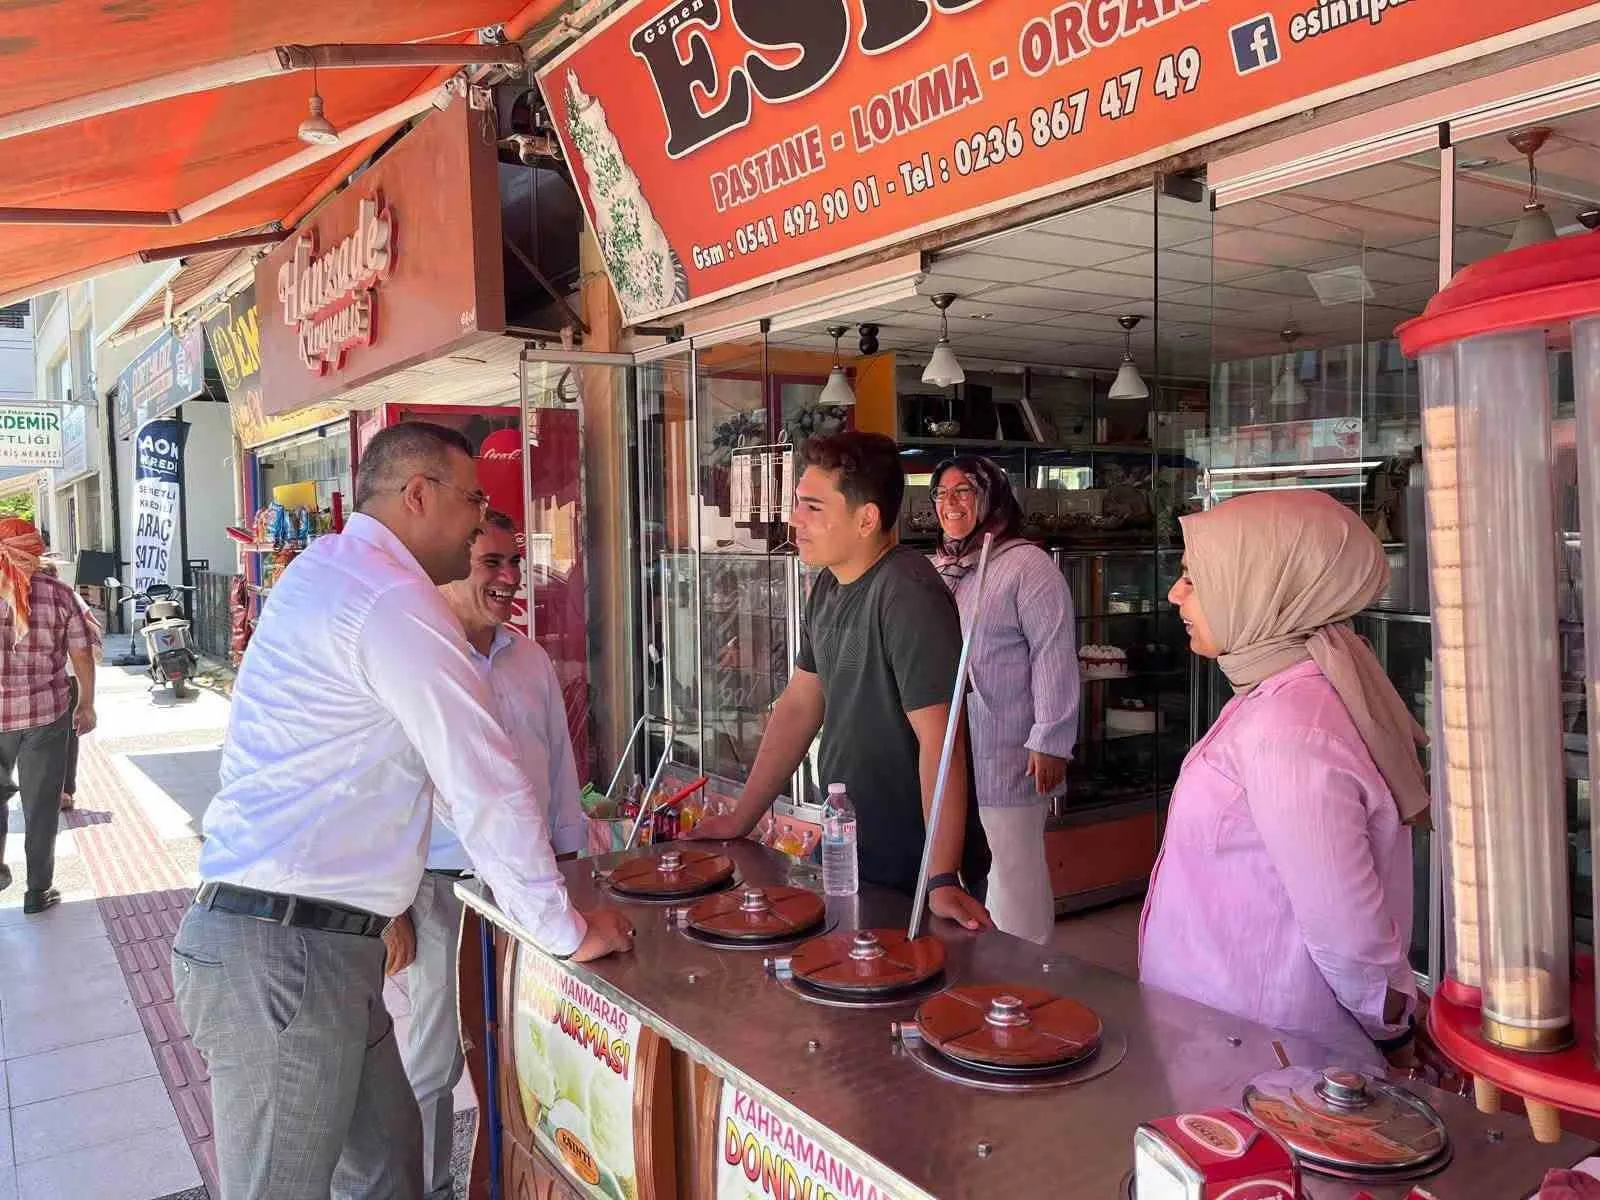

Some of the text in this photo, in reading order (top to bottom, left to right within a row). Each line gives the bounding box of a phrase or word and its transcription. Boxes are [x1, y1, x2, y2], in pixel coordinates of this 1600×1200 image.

[644, 0, 704, 44] Gönen
[630, 0, 990, 160] ES
[692, 243, 725, 270] Gsm
[735, 215, 778, 254] 0541
[782, 200, 820, 238] 492
[821, 180, 850, 225] 90
[852, 174, 881, 213] 01
[898, 152, 936, 197] Tel
[953, 116, 1024, 177] 0236
[1030, 88, 1090, 148] 867
[1098, 66, 1144, 121] 47
[1152, 45, 1202, 100] 49
[711, 125, 826, 213] PASTANE
[850, 53, 982, 153] LOKMA
[0, 412, 60, 431] DEMİR
[135, 545, 168, 577] SATIŞ
[136, 512, 172, 546] ARAÇ
[724, 1116, 839, 1200] DONDU
[734, 1090, 893, 1200] KAHRAMANMA
